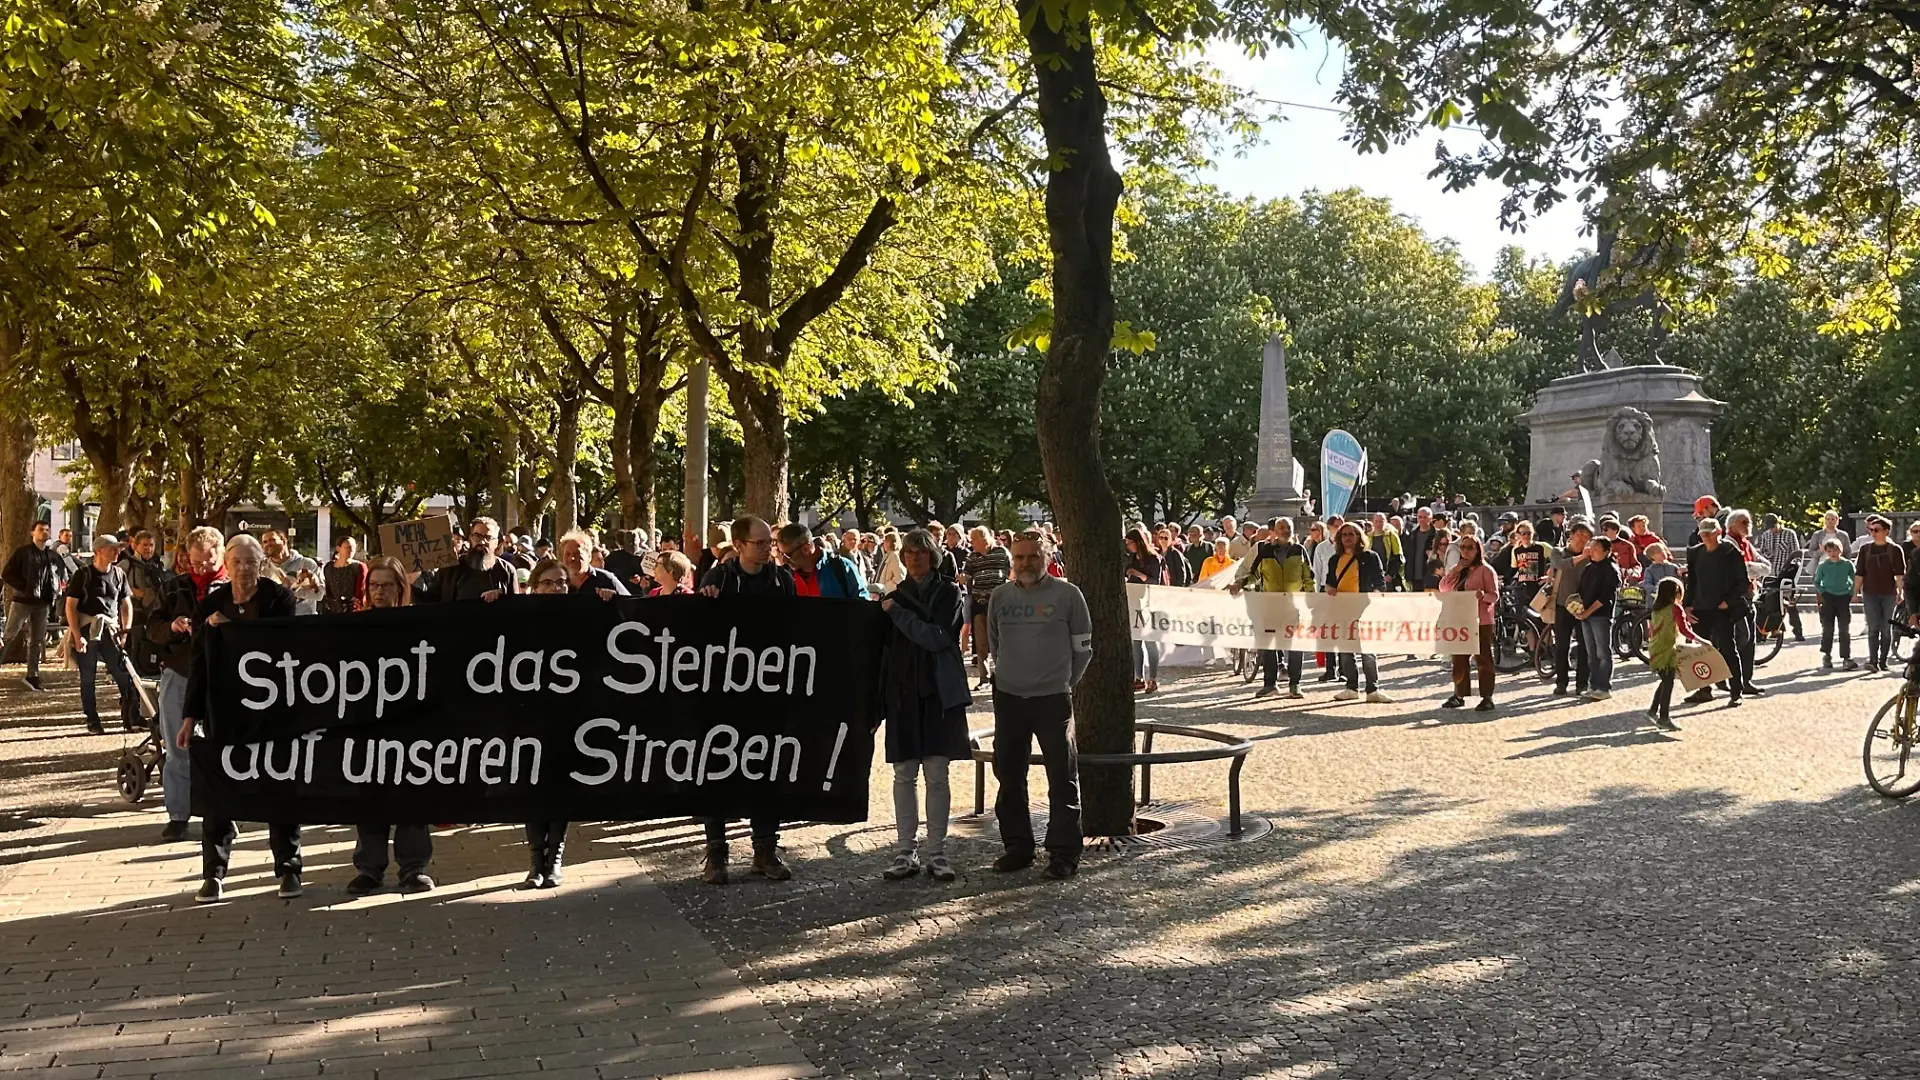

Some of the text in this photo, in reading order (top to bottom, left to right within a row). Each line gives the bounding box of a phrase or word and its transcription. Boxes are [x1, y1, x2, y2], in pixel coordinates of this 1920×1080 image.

[394, 522, 428, 544] MEHR
[1001, 604, 1035, 618] VCD
[1133, 609, 1254, 637] Menschen
[1284, 622, 1340, 640] statt
[1347, 619, 1387, 641] für
[1396, 620, 1470, 642] Autos
[238, 621, 817, 719] Stoppt das Sterben
[221, 728, 327, 784] auf
[342, 736, 542, 785] unseren
[569, 718, 802, 786] Straßen
